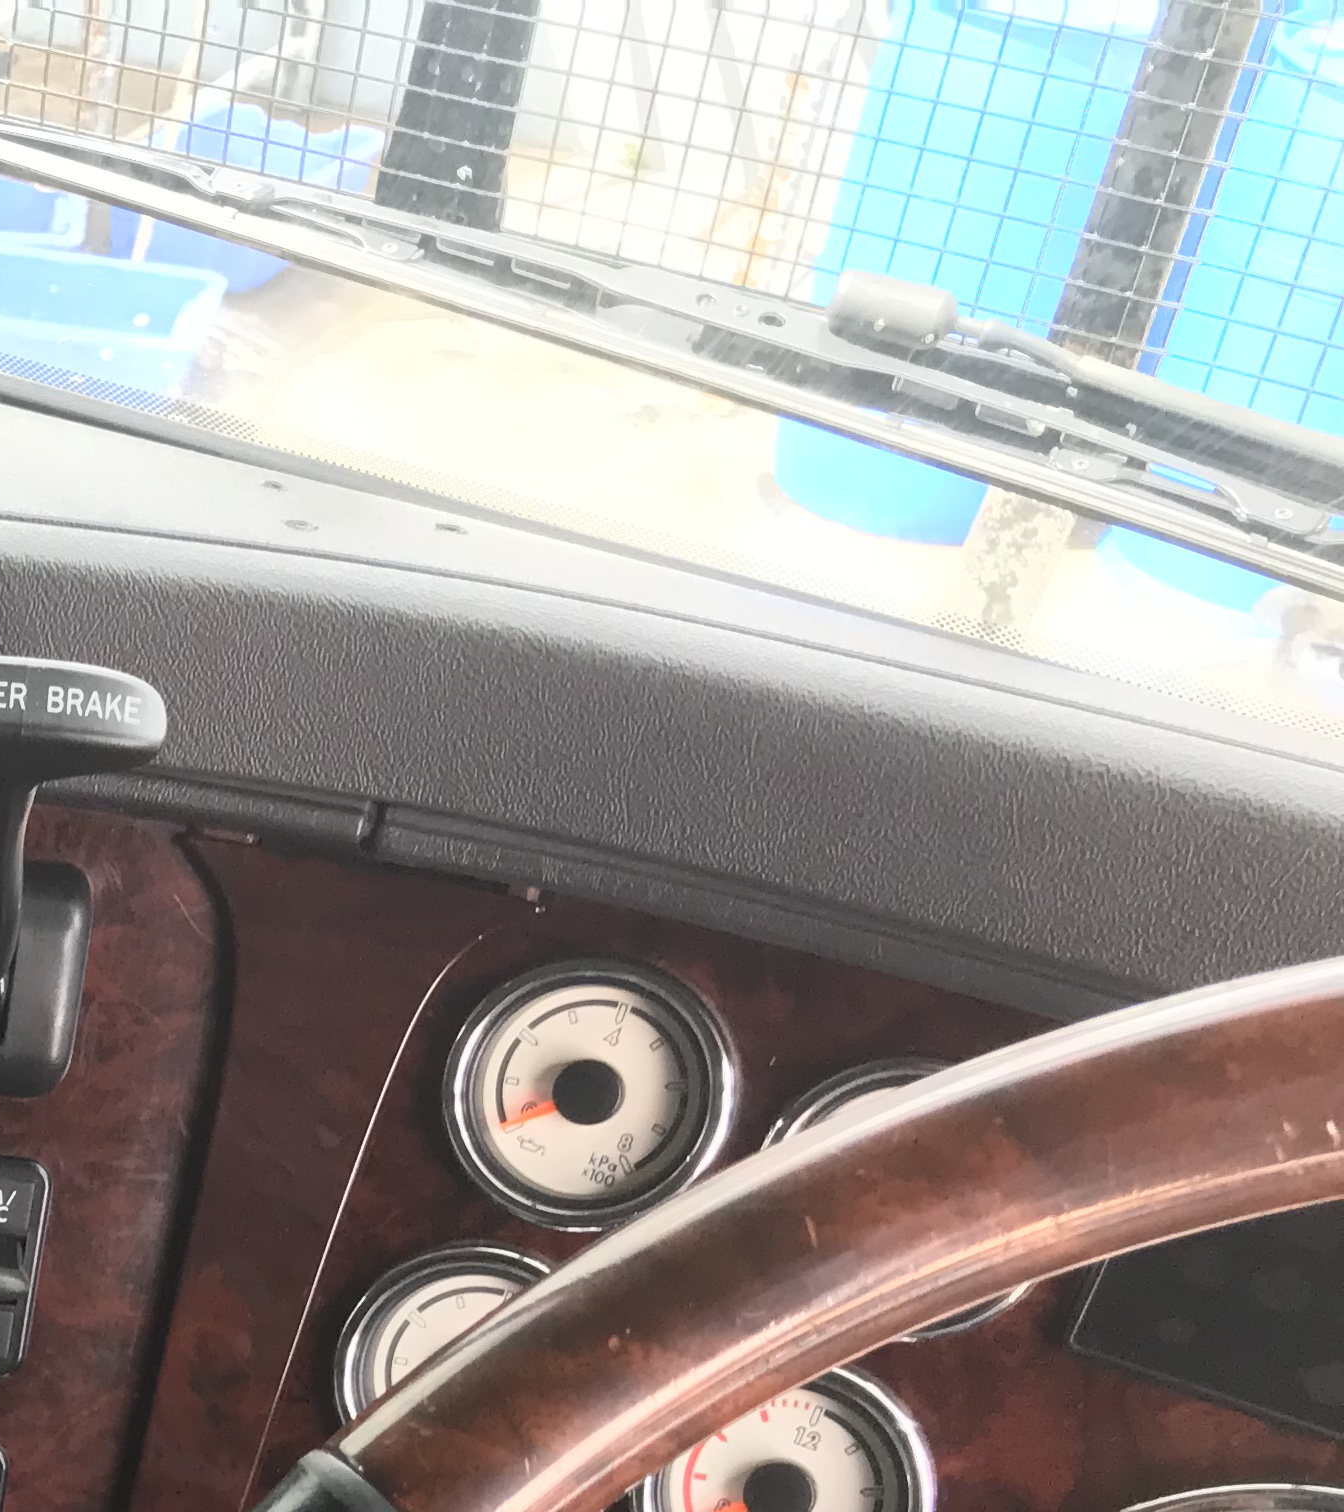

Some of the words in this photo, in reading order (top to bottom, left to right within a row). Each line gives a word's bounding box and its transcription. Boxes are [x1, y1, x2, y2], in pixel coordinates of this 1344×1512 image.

[46, 685, 142, 724] BRAKE
[602, 1026, 623, 1047] 4
[617, 1133, 634, 1152] 8
[588, 1152, 618, 1172] kPa
[793, 1426, 822, 1452] 12
